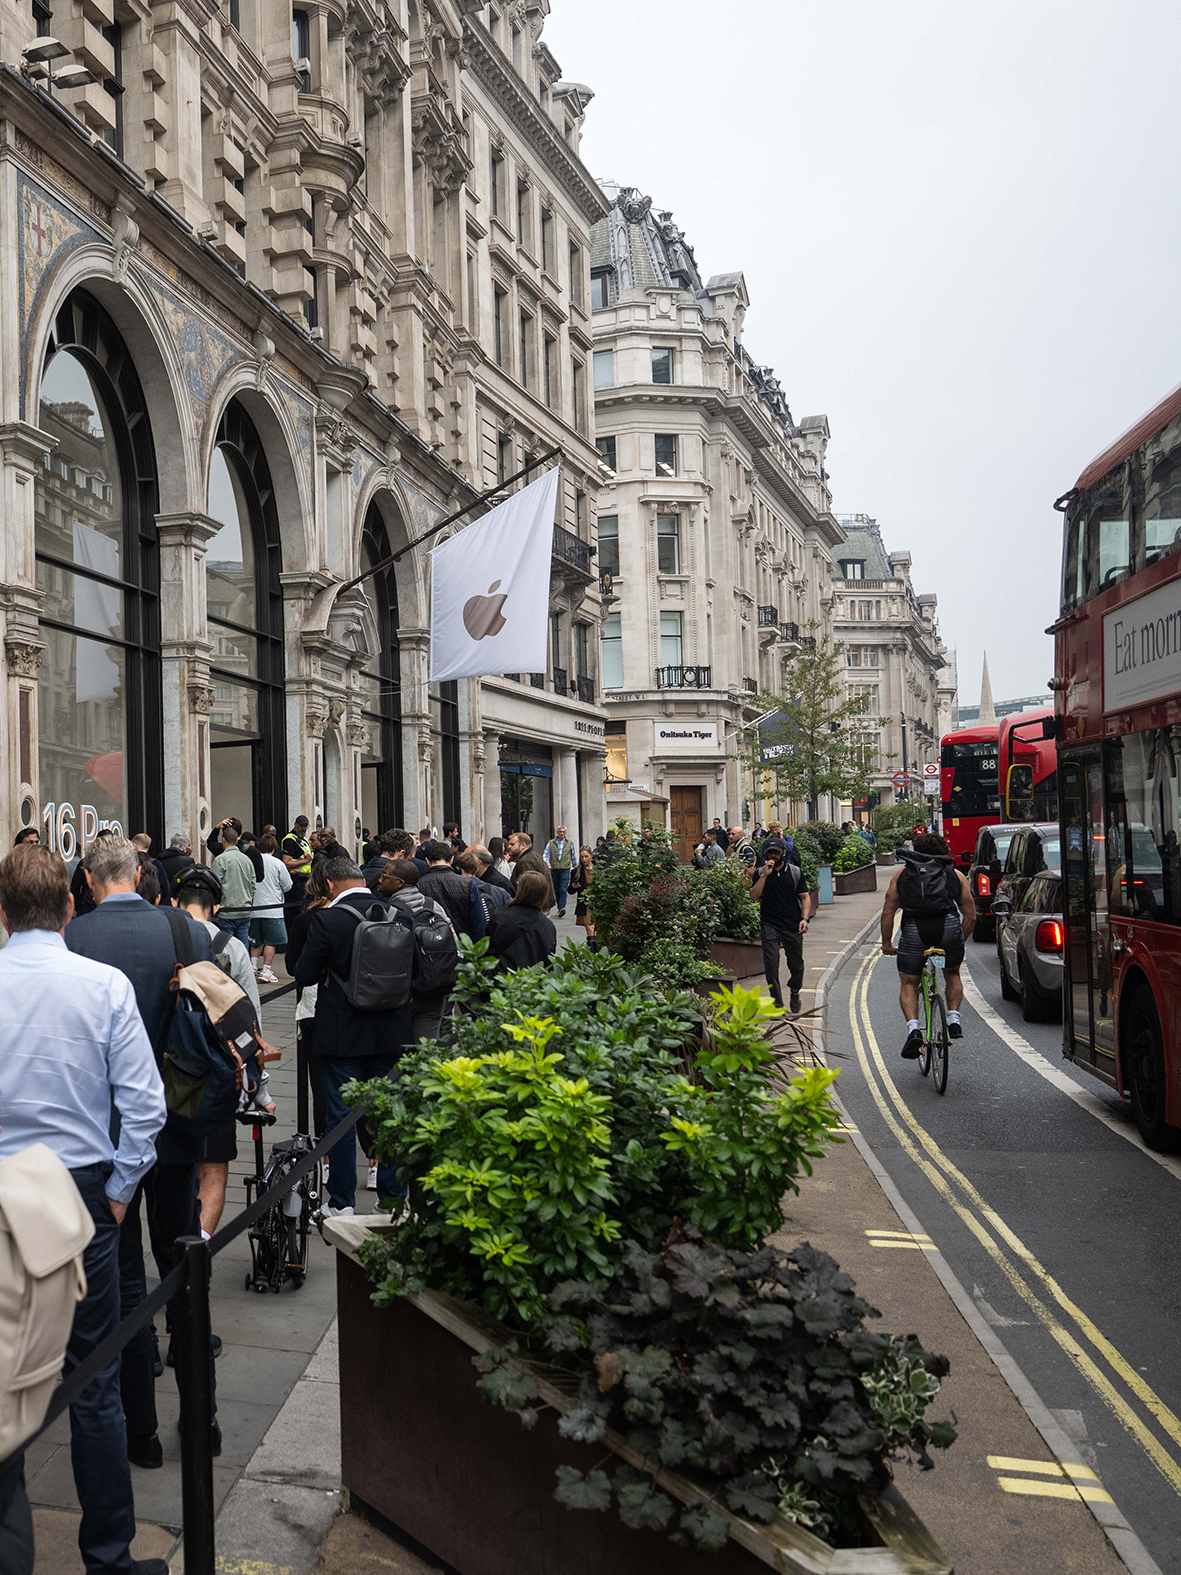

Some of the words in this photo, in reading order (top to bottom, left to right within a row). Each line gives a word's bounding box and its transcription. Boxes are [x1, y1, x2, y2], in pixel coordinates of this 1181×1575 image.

[1113, 620, 1137, 676] Eat
[660, 730, 692, 738] Onitsuka
[693, 730, 712, 739] Tiger
[982, 759, 996, 770] 88
[42, 802, 77, 863] 16
[80, 804, 124, 859] Po
